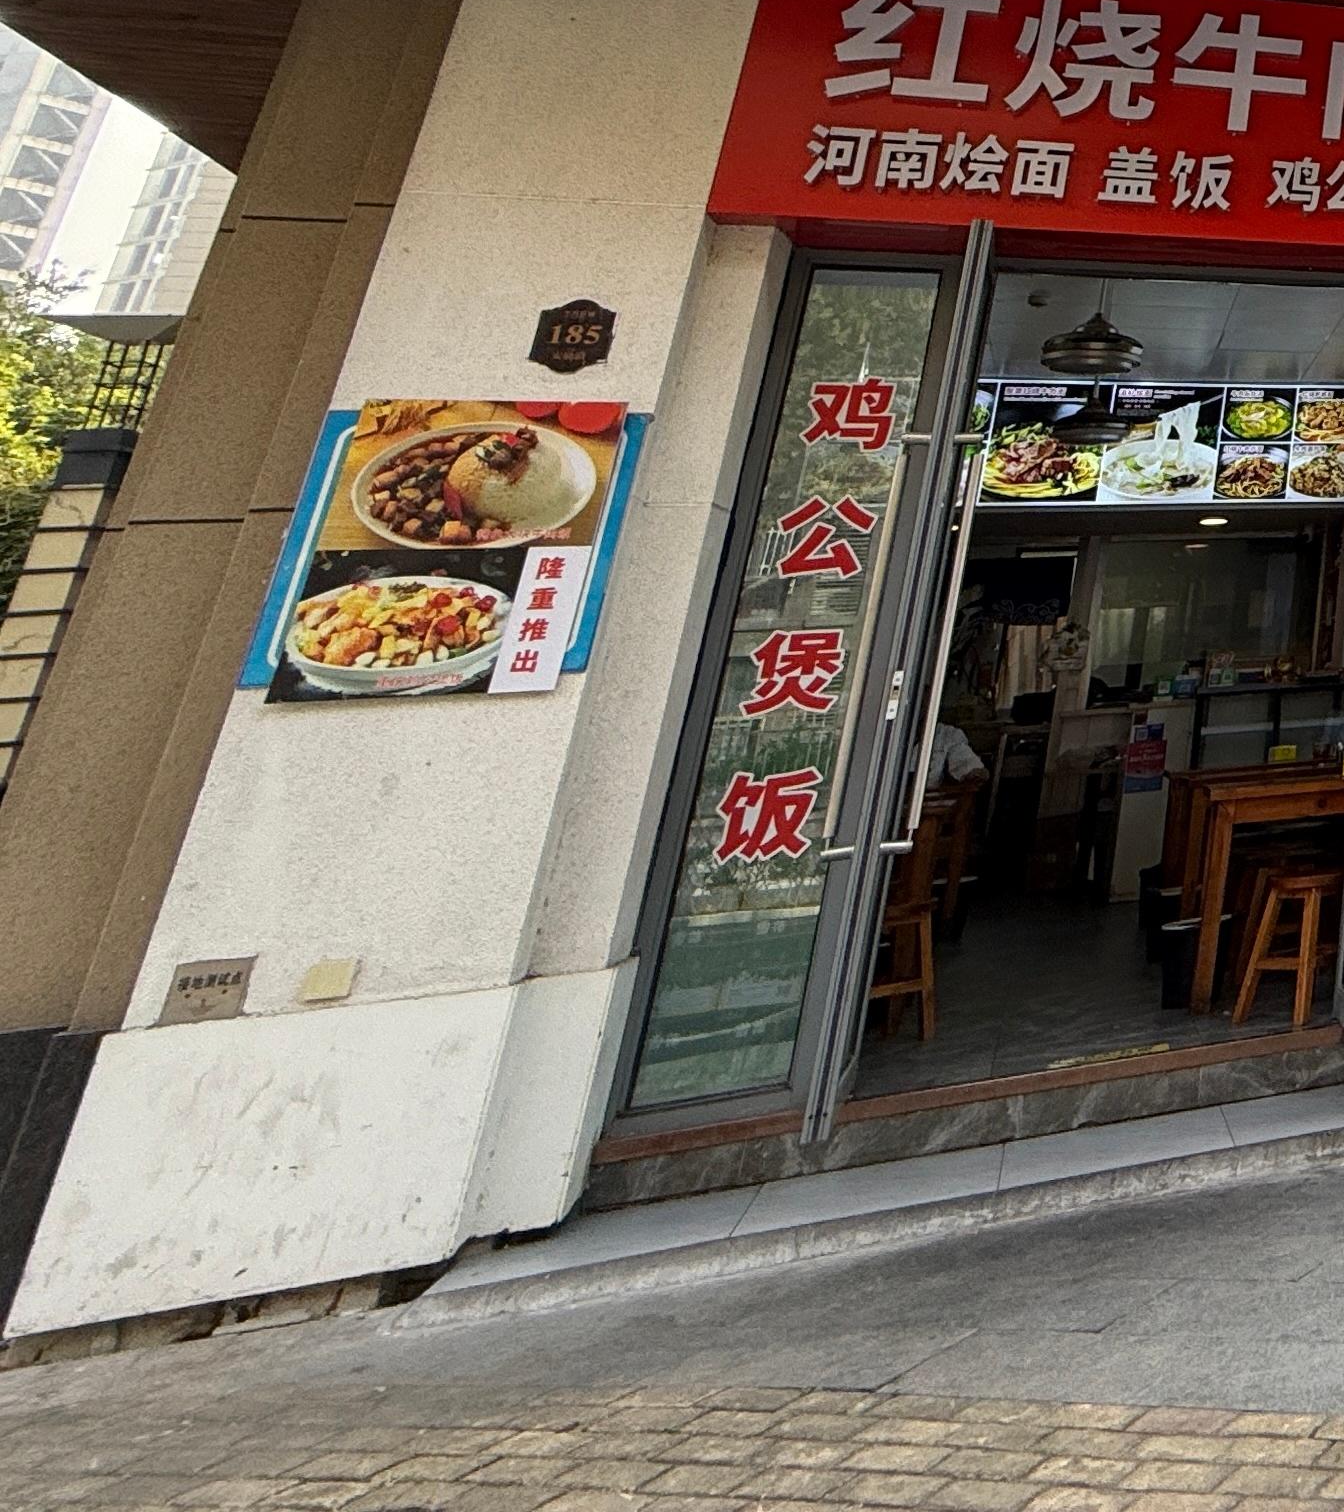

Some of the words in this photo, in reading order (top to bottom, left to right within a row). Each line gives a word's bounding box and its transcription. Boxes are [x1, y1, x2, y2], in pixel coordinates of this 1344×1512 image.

[803, 125, 1074, 201] 河南烩面
[1096, 146, 1234, 211] 盖饭
[546, 324, 603, 345] 185
[507, 555, 565, 676] 隆重推出
[713, 376, 902, 866] 鸡公煲饭
